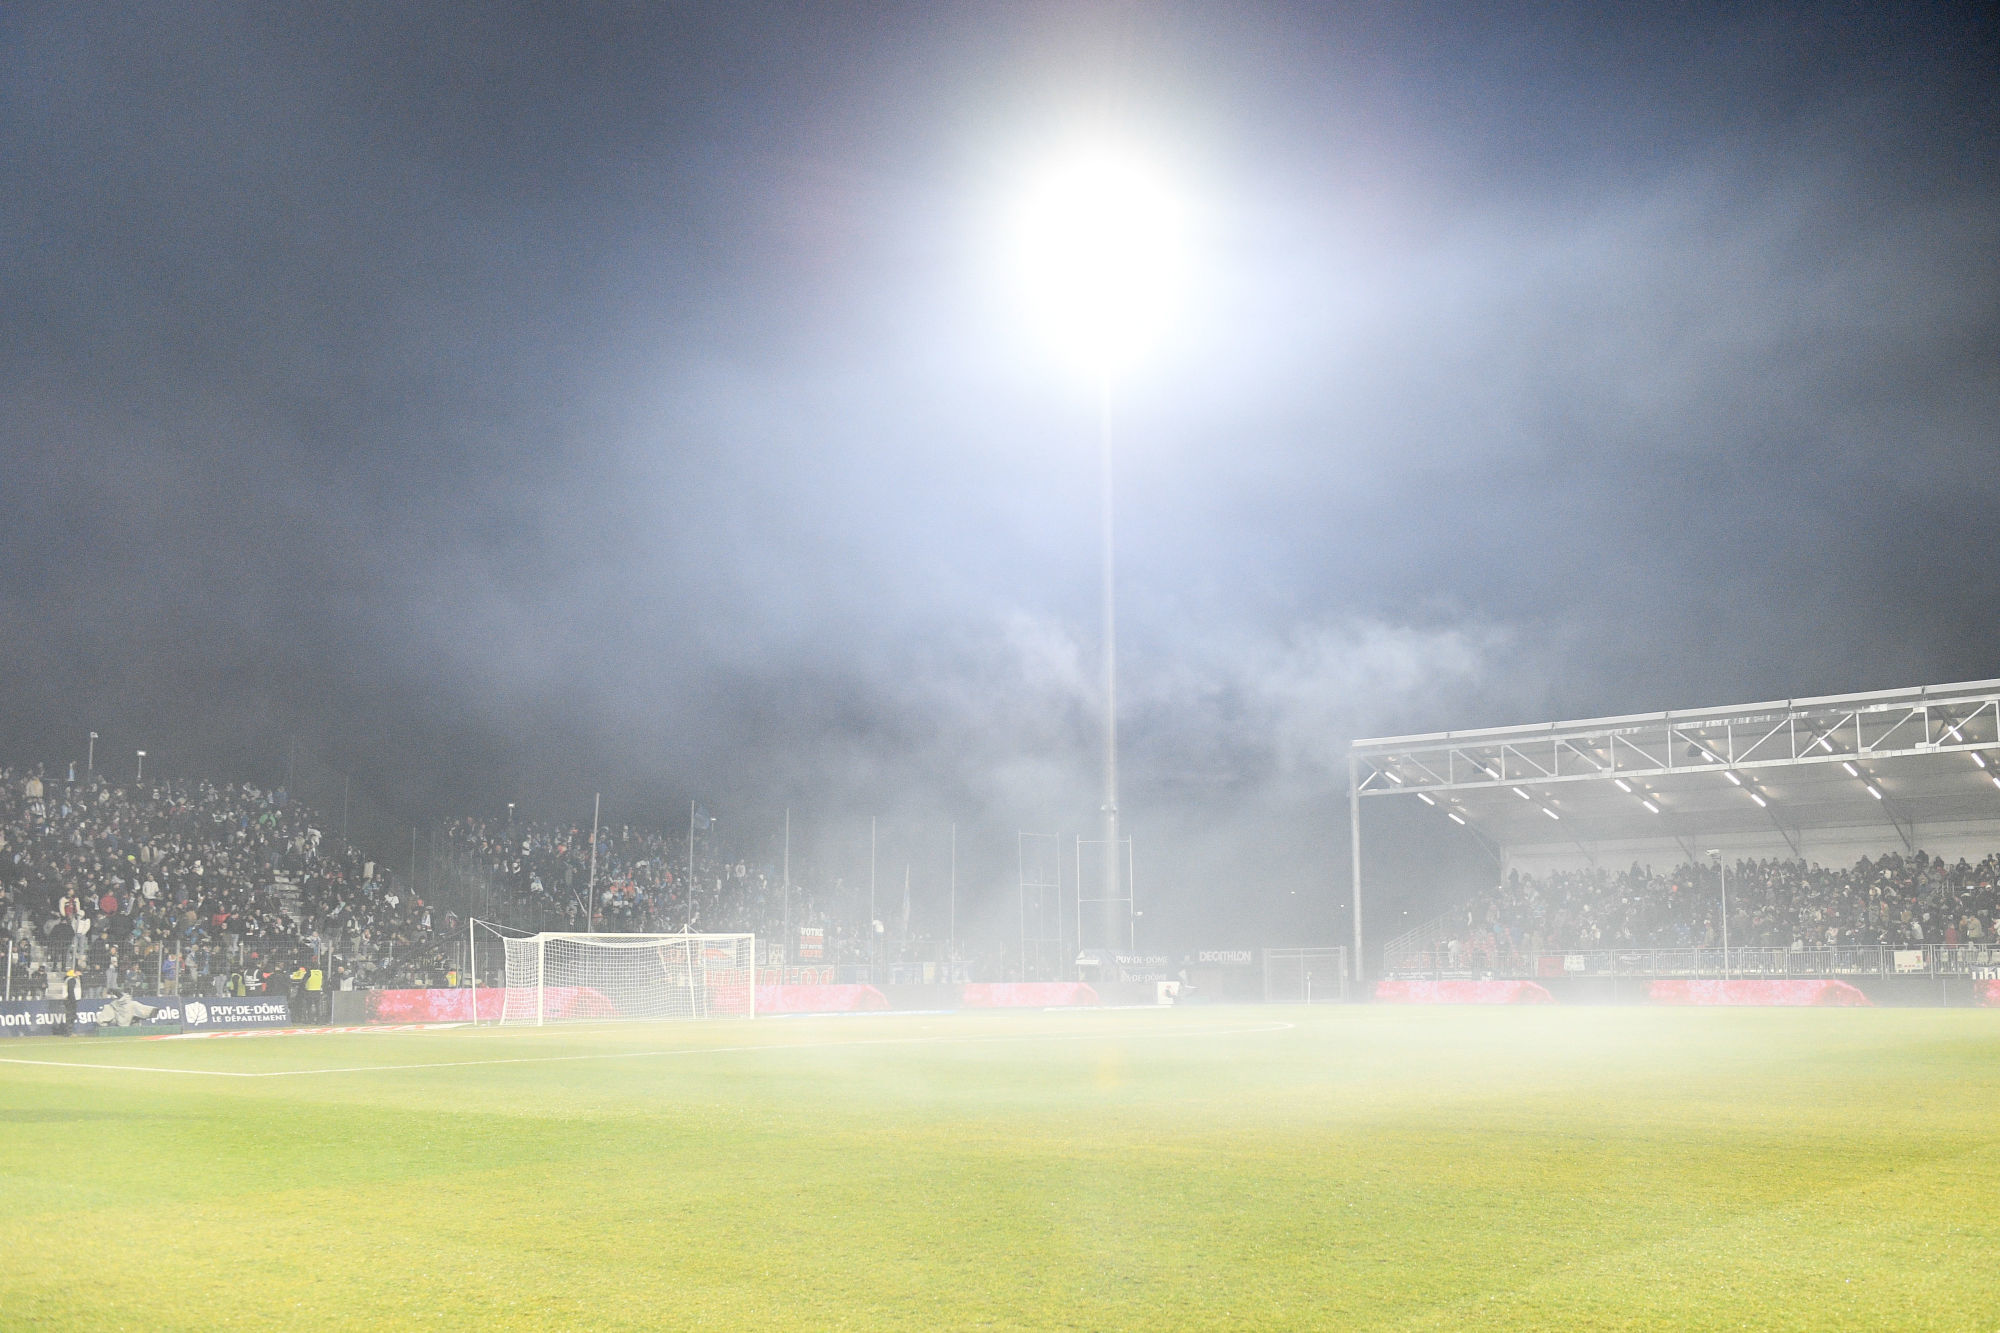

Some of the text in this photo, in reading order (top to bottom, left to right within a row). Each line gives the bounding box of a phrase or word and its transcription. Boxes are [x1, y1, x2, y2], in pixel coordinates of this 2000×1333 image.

[800, 927, 824, 937] VOTRE
[210, 1003, 286, 1016] PUY-DE-DÔME
[225, 1014, 287, 1023] DÉPARTEMENT
